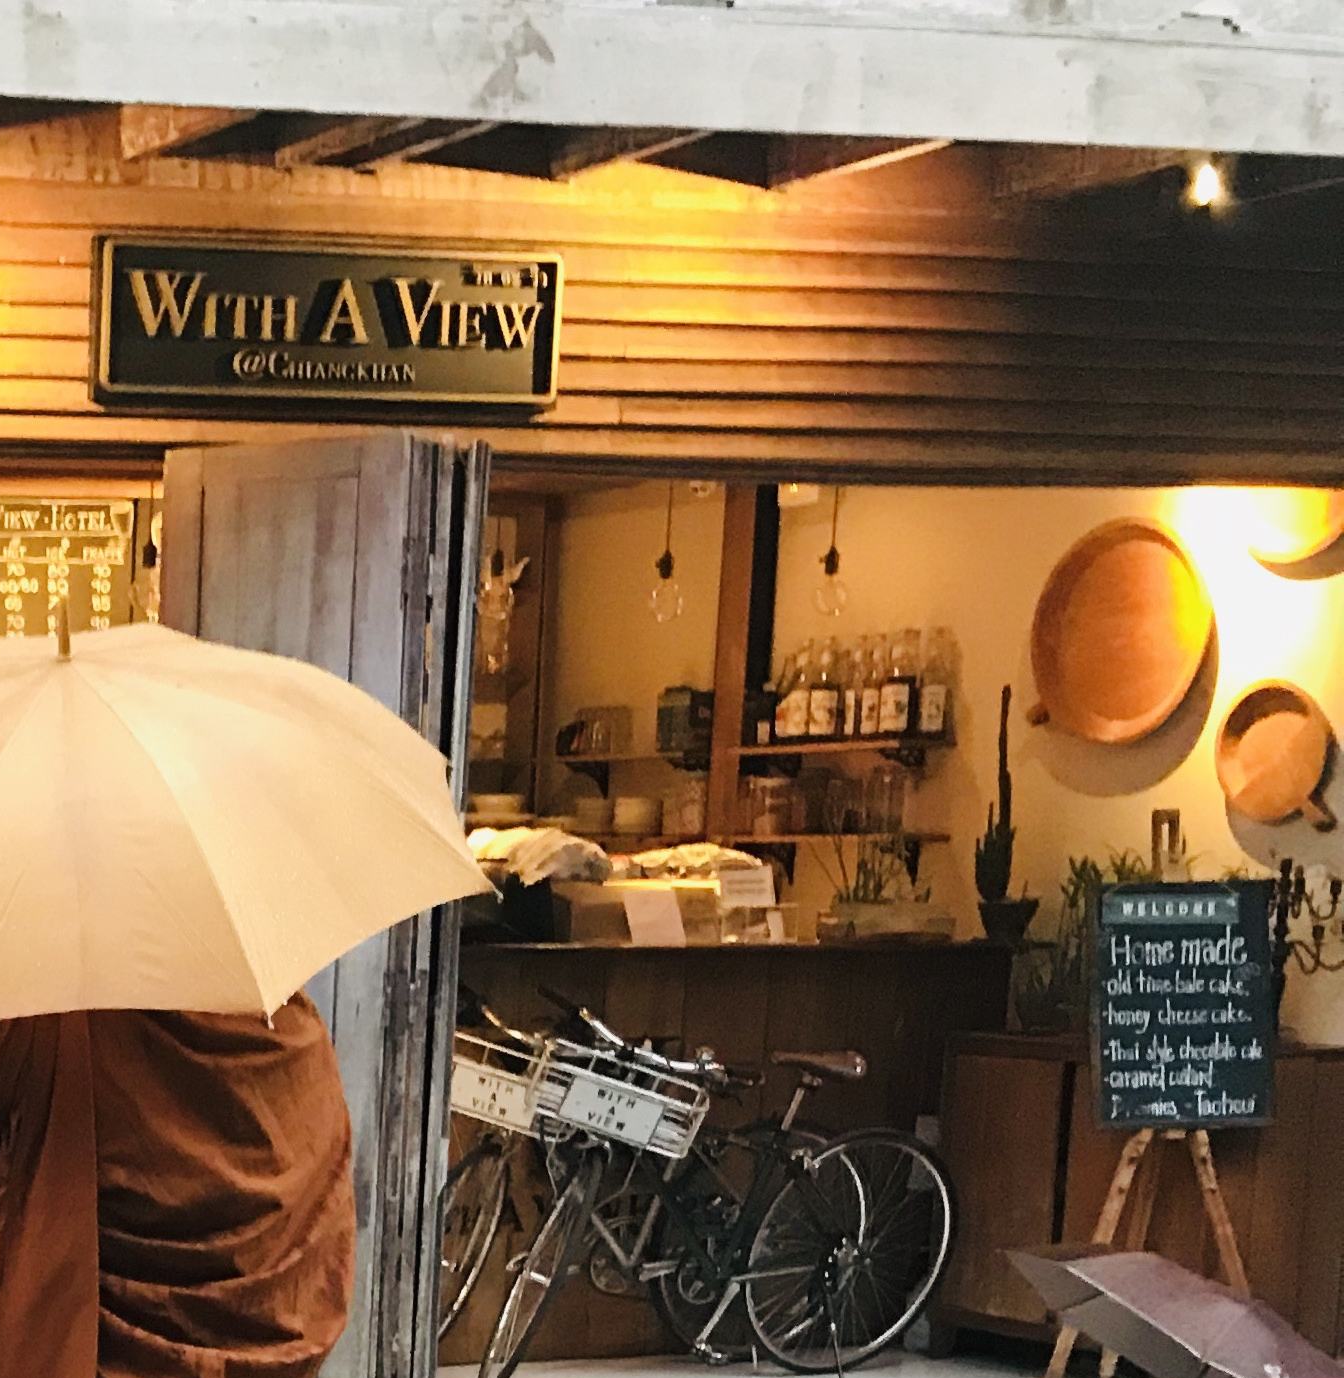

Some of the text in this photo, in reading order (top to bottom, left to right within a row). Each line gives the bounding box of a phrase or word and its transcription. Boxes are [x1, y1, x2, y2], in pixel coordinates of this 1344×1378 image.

[319, 277, 369, 346] A
[1122, 901, 1216, 917] WELCOME
[1111, 925, 1248, 967] Home made
[1158, 998, 1208, 1026] cheese
[478, 1076, 513, 1095] WITH
[472, 1097, 507, 1117] VIEW
[597, 1088, 636, 1109] WITH
[587, 1112, 626, 1132] VIEW
